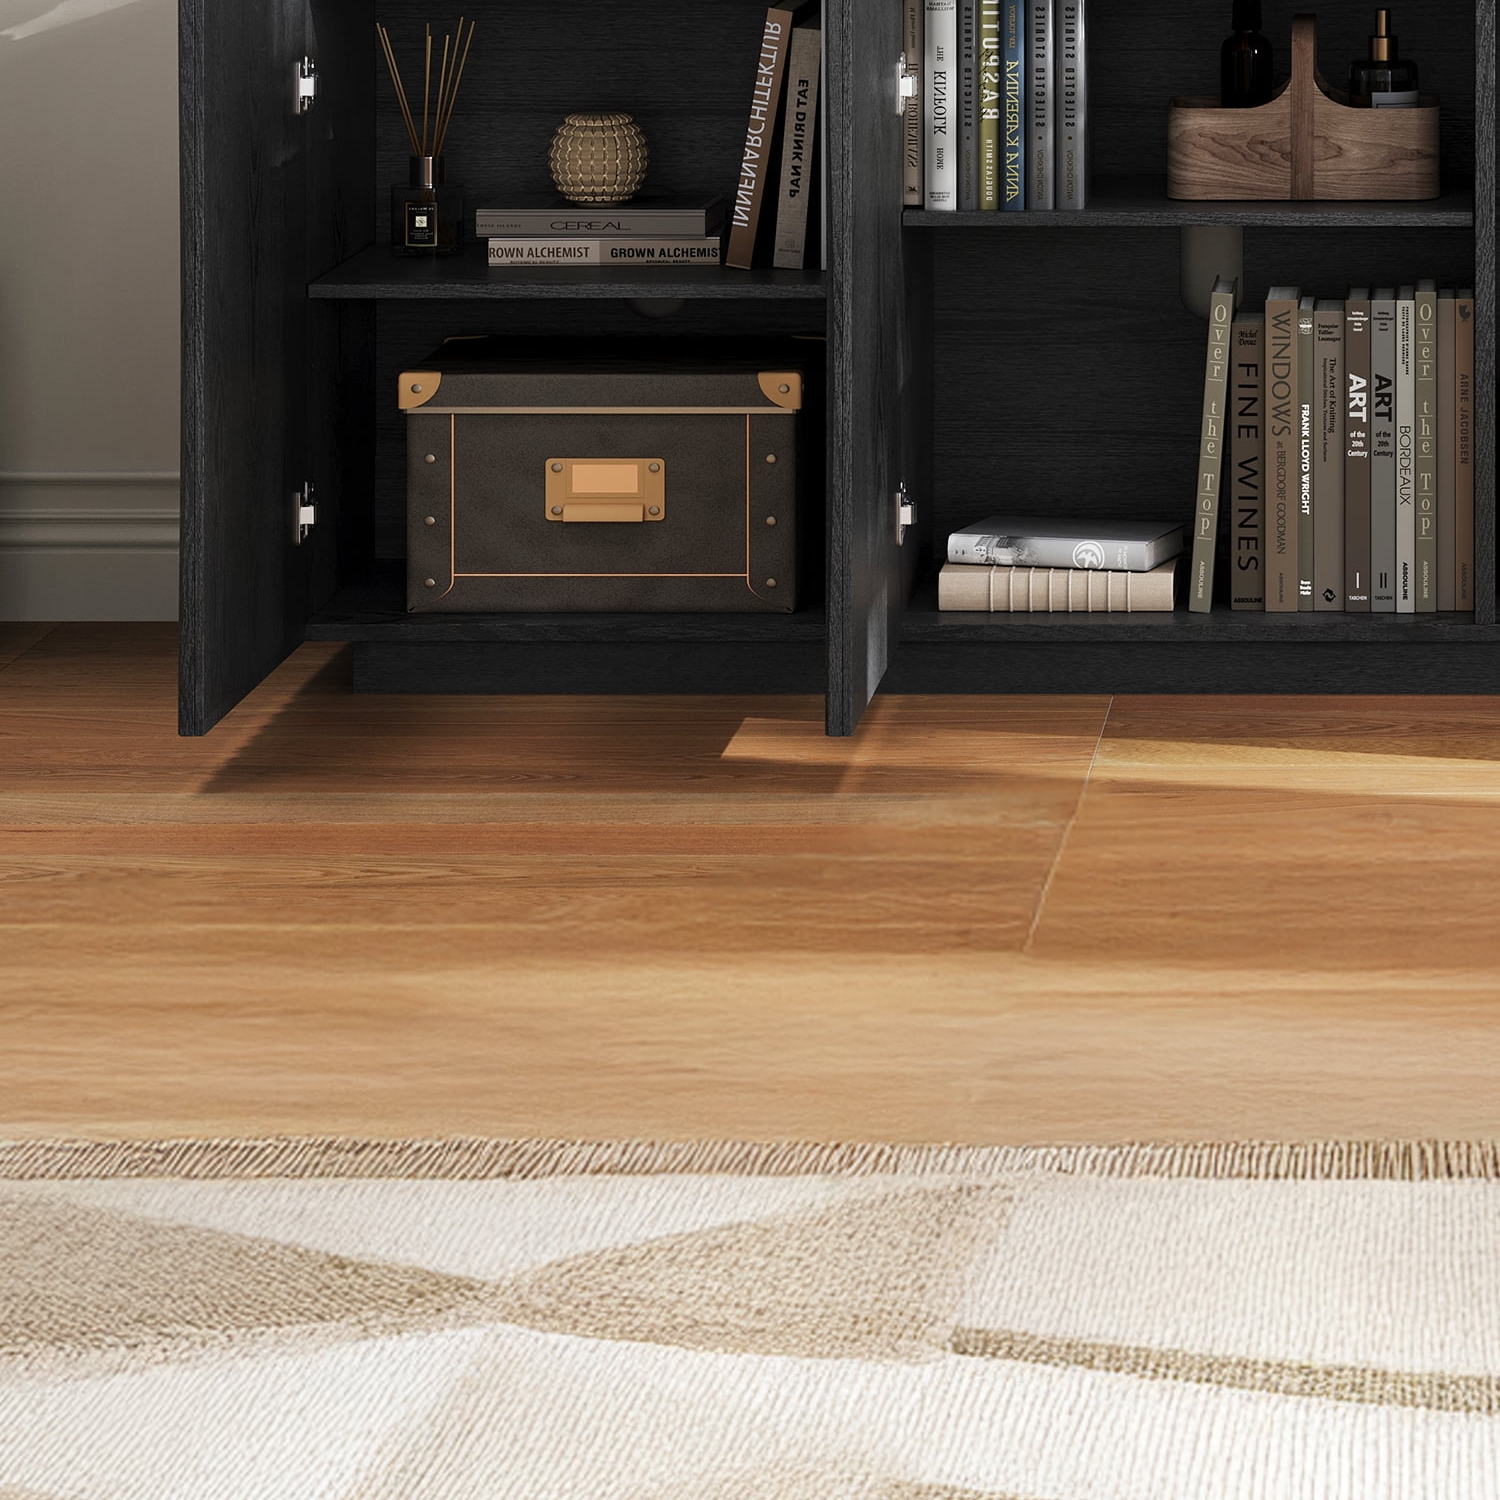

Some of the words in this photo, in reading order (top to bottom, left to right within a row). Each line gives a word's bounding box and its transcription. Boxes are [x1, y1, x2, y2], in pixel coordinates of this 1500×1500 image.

[550, 221, 631, 230] CEREAL
[527, 246, 590, 258] ALCHEMIST
[610, 248, 655, 258] GROWN
[1213, 304, 1227, 378] Over
[1419, 303, 1432, 376] Over
[1271, 309, 1291, 437] WINDOWS
[1329, 357, 1337, 373] The
[1329, 375, 1337, 388] Art
[1238, 363, 1258, 439] FINE
[1329, 390, 1337, 398] of
[1348, 373, 1367, 423] ART
[1374, 373, 1392, 423] ART
[1460, 374, 1469, 403] ARNE
[1207, 401, 1217, 454] the
[1301, 404, 1310, 438] FRANK
[1328, 401, 1337, 434] Knitting
[1349, 430, 1356, 438] of
[1356, 430, 1366, 438] the
[1375, 430, 1382, 438] of
[1382, 430, 1391, 438] the
[1421, 400, 1430, 454] the
[1460, 407, 1469, 464] JACOBSEN
[1276, 450, 1286, 501] BERGDORF
[1301, 440, 1310, 472] LLOYD
[1347, 450, 1368, 458] Century
[1373, 450, 1393, 458] Century
[1399, 426, 1411, 506] BORDEAUX
[1200, 473, 1215, 536] Top
[1237, 456, 1258, 571] WINES
[1301, 473, 1310, 515] WRIGHT
[1420, 473, 1432, 536] Top
[1276, 502, 1286, 555] GOODMAN
